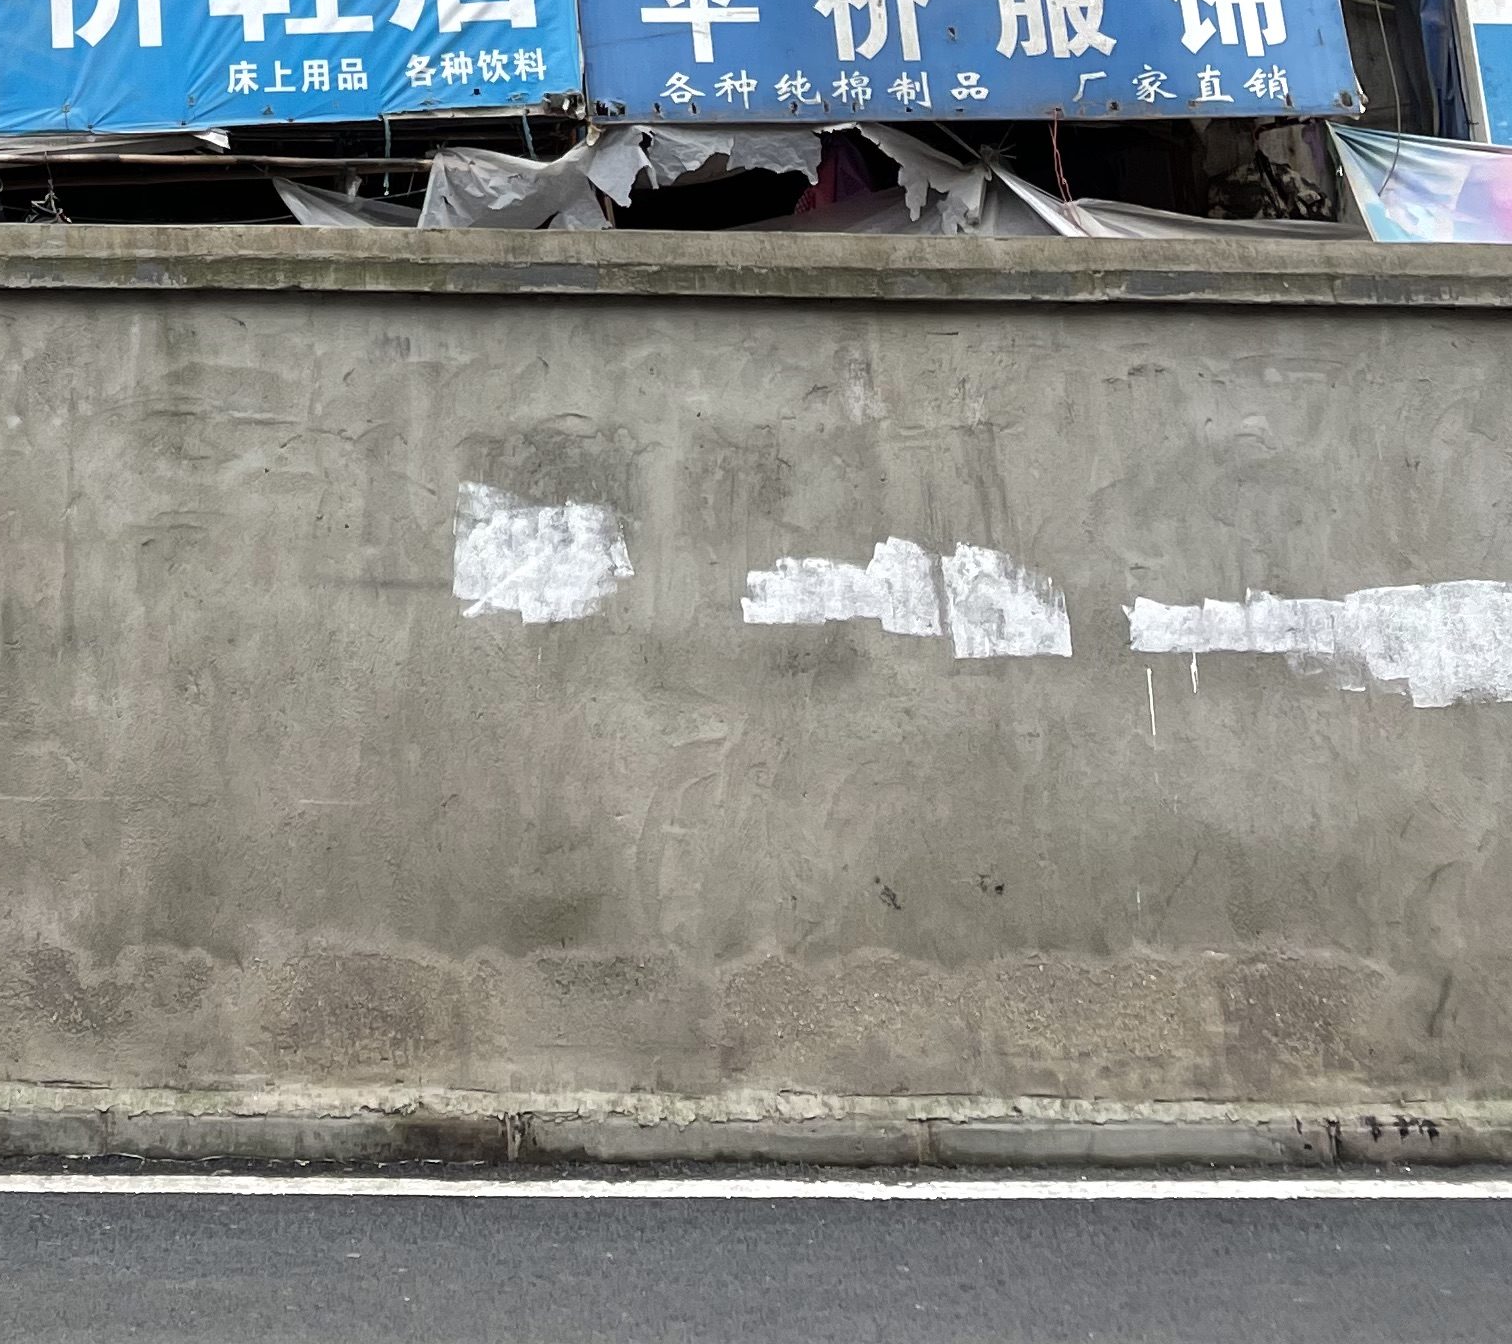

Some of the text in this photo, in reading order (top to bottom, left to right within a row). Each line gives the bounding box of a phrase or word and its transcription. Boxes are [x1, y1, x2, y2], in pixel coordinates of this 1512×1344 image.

[227, 48, 548, 94] 床上用品 各种饮料
[659, 64, 1290, 109] 各种纯棉制品 厂家直销
